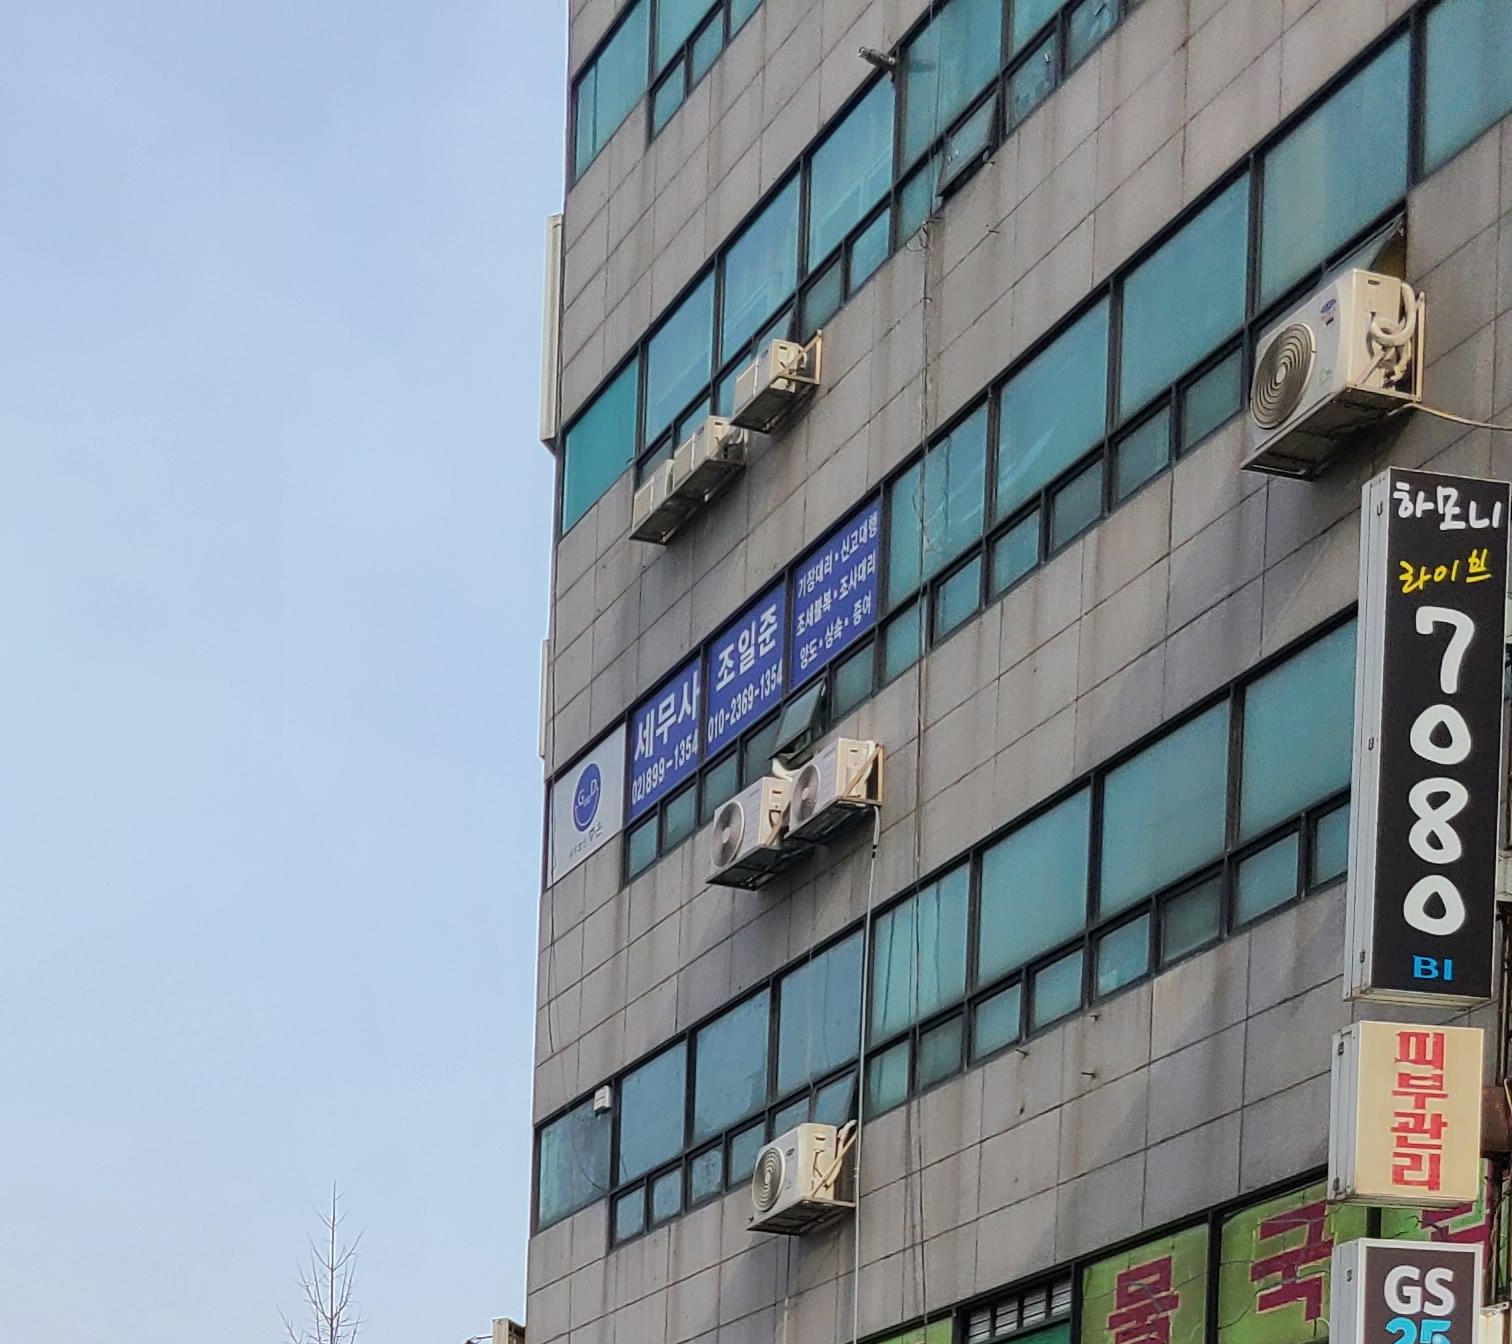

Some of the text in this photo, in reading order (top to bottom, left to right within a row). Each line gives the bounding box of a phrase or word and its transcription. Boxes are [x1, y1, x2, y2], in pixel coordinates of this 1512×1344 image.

[1393, 482, 1501, 531] 하모니
[715, 603, 778, 692] 조일준
[634, 671, 701, 762] 세무사
[1403, 605, 1475, 936] 7080
[1391, 1030, 1449, 1193] 피부관리
